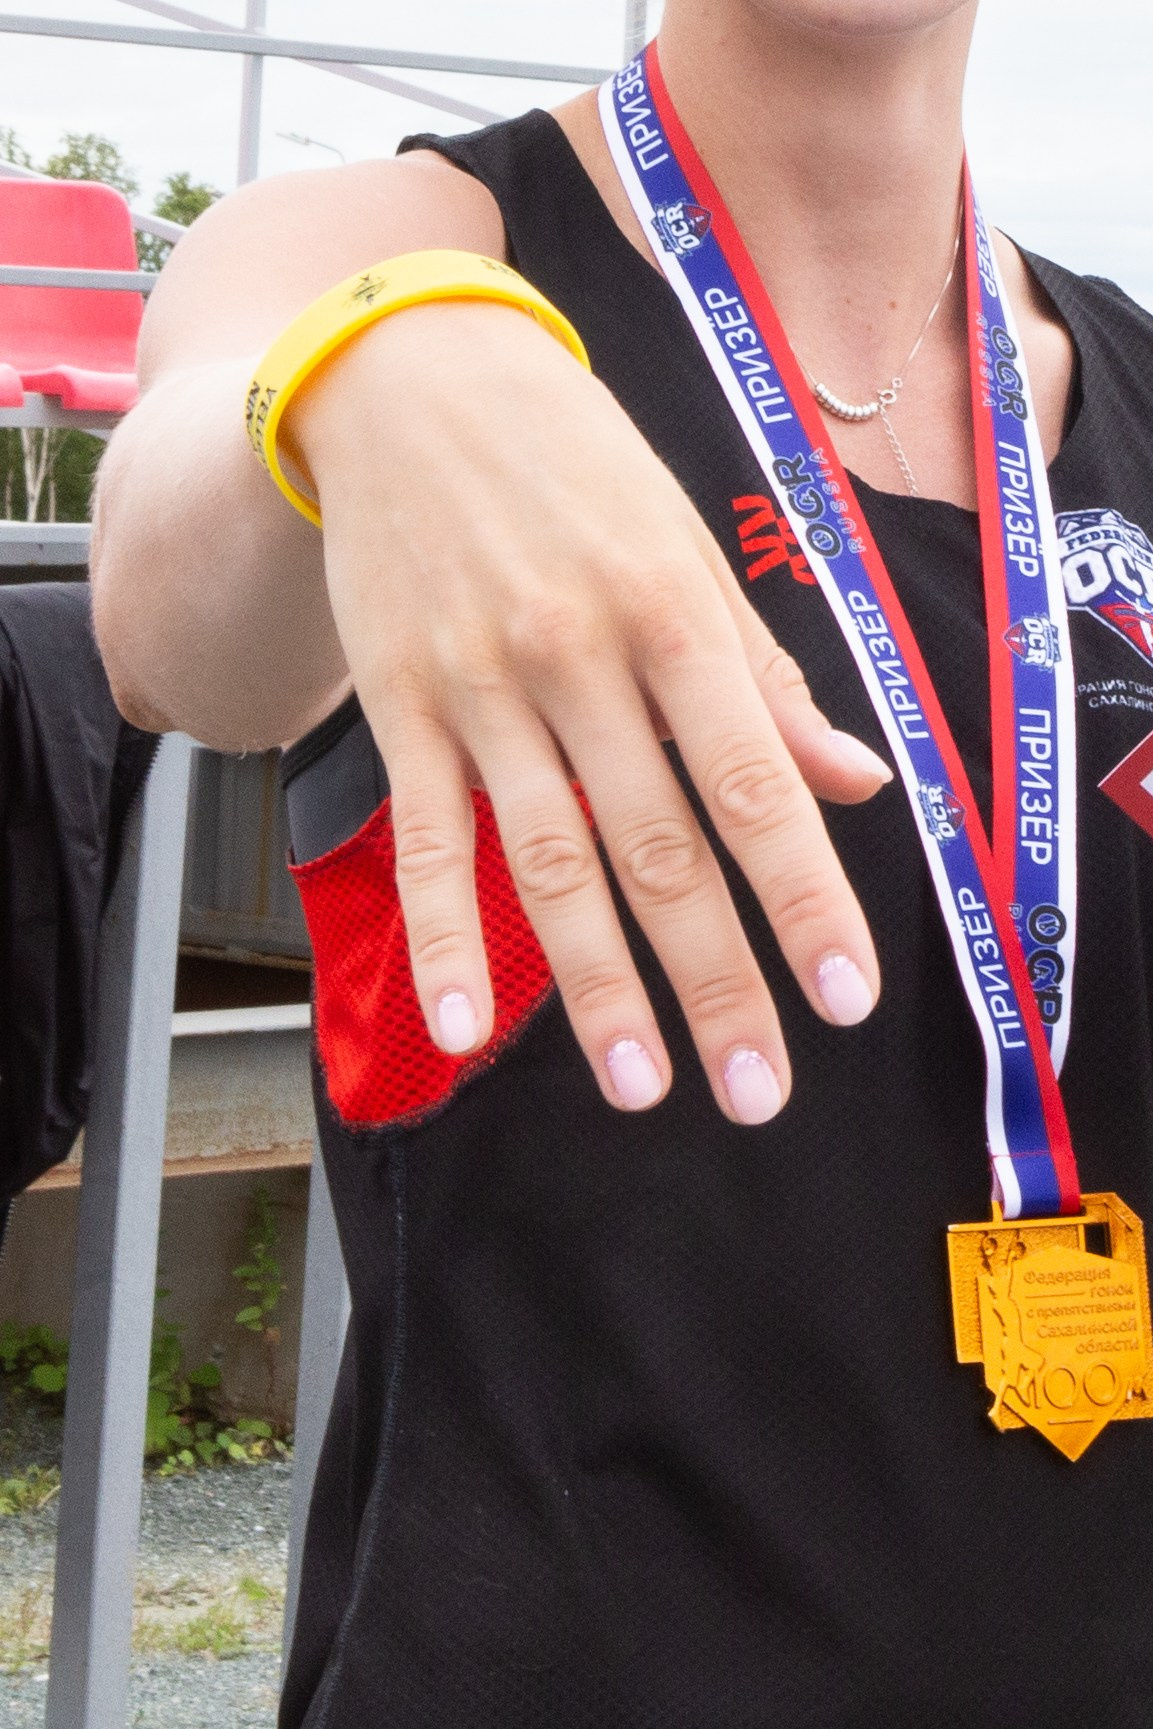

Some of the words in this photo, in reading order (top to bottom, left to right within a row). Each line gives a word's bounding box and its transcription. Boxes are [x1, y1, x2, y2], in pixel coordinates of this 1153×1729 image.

[1076, 678, 1127, 698] РАЦИЯ
[1023, 1268, 1111, 1286] Федерация
[1036, 1317, 1138, 1339] Сахалинской
[1075, 1339, 1140, 1355] области
